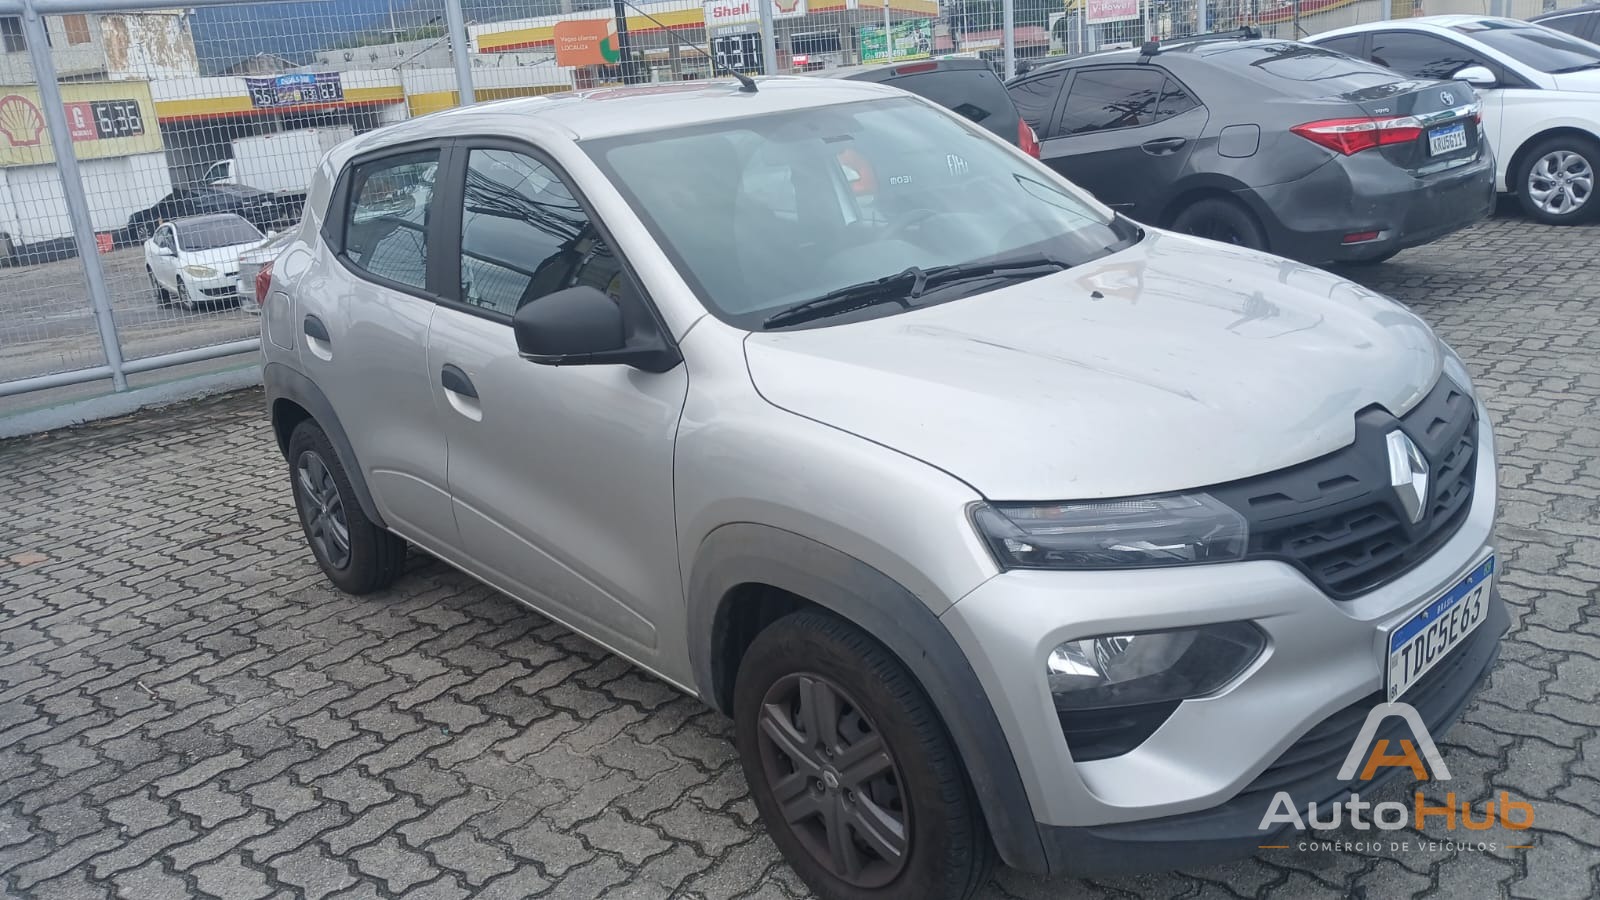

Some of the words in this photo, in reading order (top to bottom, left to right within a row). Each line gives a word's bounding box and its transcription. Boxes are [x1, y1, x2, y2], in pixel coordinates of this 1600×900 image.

[713, 3, 750, 18] Shell
[560, 43, 589, 51] LOCALIZA
[72, 107, 85, 129] G
[1433, 131, 1463, 152] KRU5G11
[1401, 586, 1483, 685] TDC5E63
[1391, 684, 1398, 699] BR
